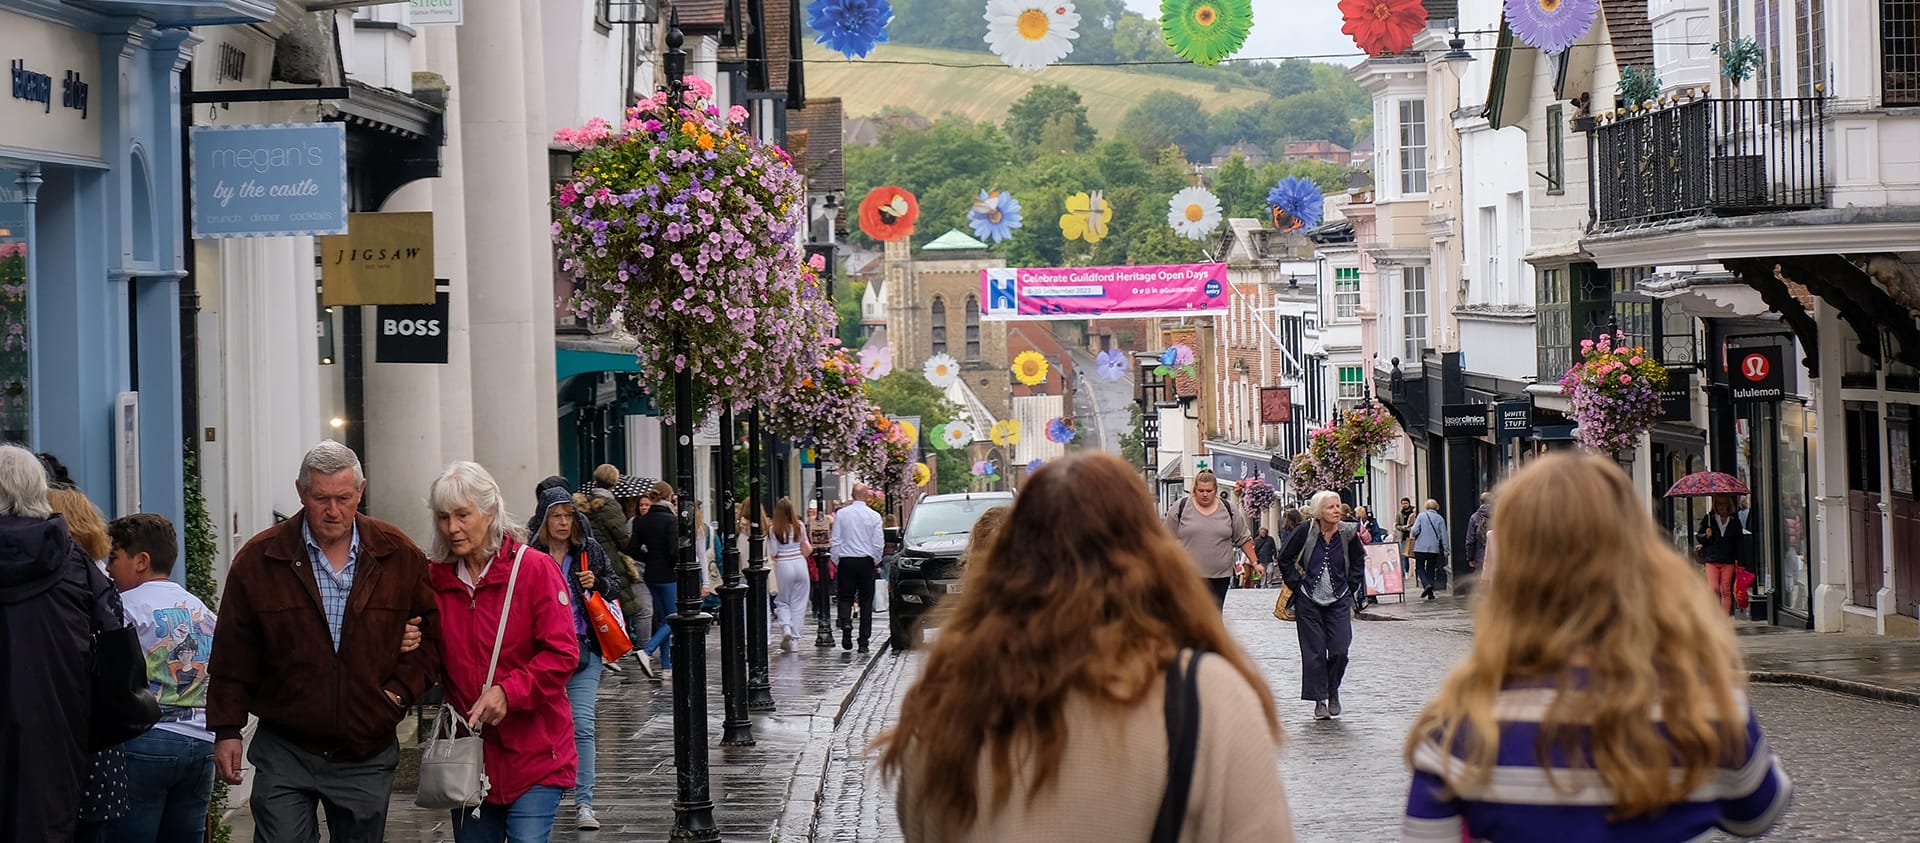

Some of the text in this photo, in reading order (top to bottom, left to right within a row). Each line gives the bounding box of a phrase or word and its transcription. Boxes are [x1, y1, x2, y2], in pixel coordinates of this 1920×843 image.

[211, 143, 323, 173] megan's
[213, 178, 319, 207] by the castle
[336, 248, 420, 264] JIGSAW
[1022, 269, 1209, 283] Celebrate Guildford Heritage Open Days
[383, 319, 441, 336] BOSS
[1734, 387, 1780, 398] lululemon
